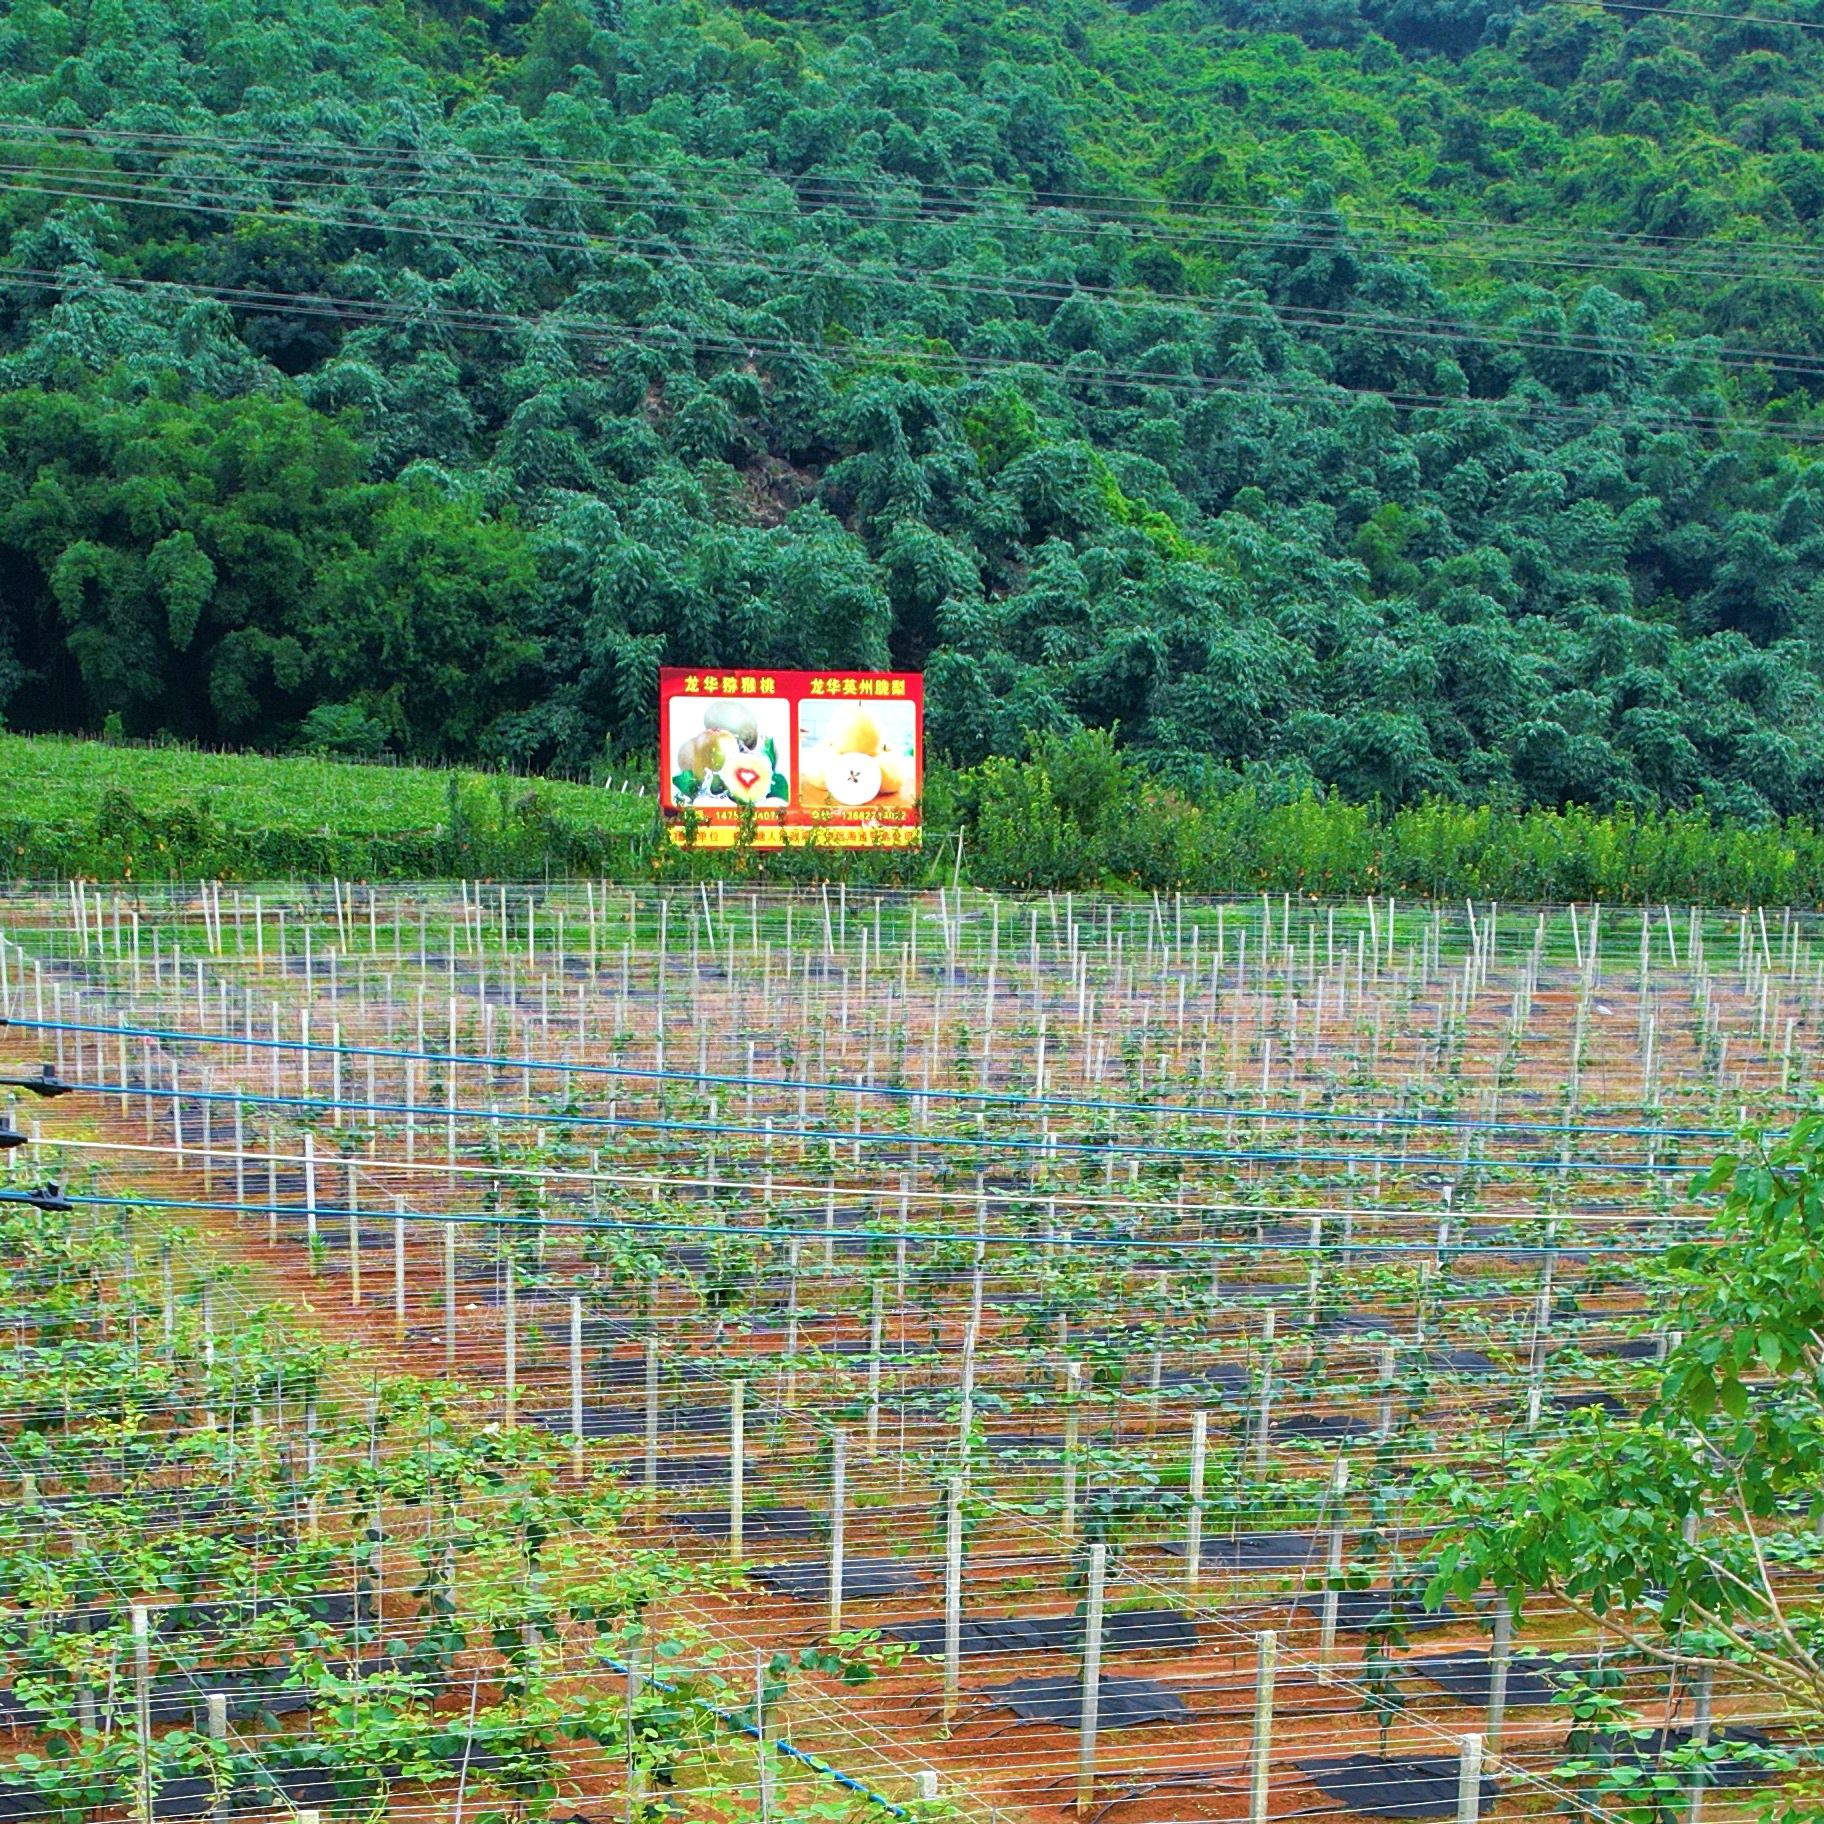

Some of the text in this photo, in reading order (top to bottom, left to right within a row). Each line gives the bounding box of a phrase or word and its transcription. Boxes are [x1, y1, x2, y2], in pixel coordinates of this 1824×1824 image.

[684, 675, 776, 694] 龙华猕猴桃
